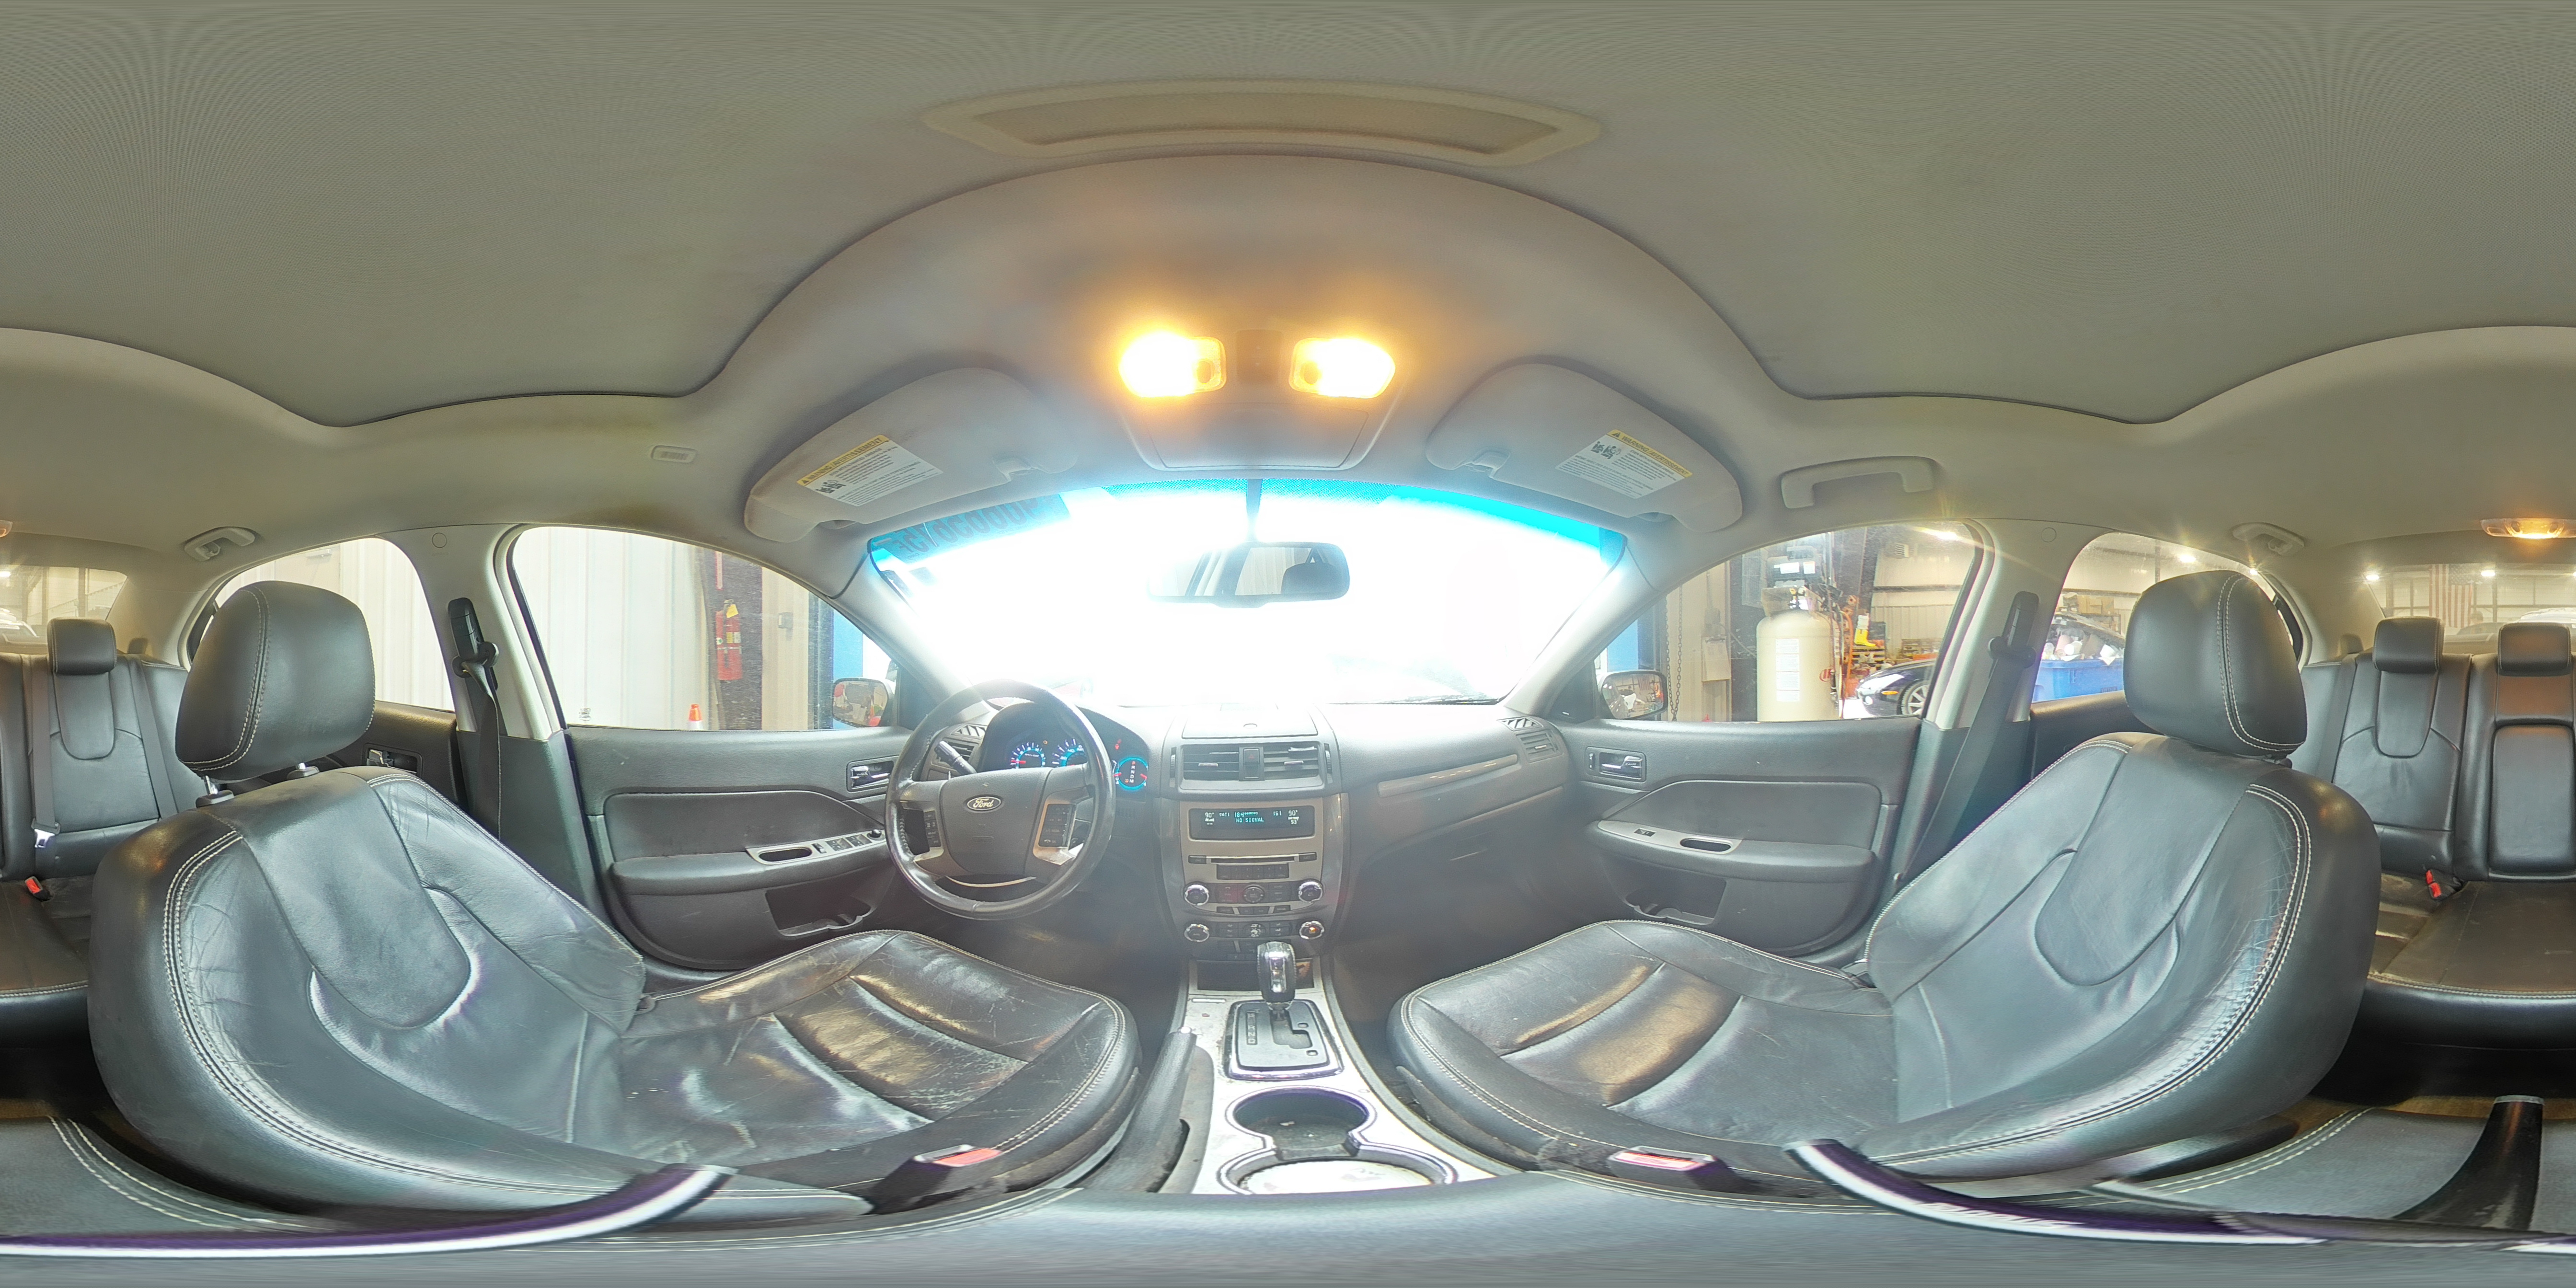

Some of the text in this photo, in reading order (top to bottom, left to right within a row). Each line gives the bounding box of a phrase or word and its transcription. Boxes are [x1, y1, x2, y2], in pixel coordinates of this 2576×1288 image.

[833, 437, 883, 466] AVERTISSEMENT
[1621, 436, 1649, 452] WARNING
[1650, 450, 1690, 475] AVERTISSEMENT
[973, 798, 994, 808] Ford
